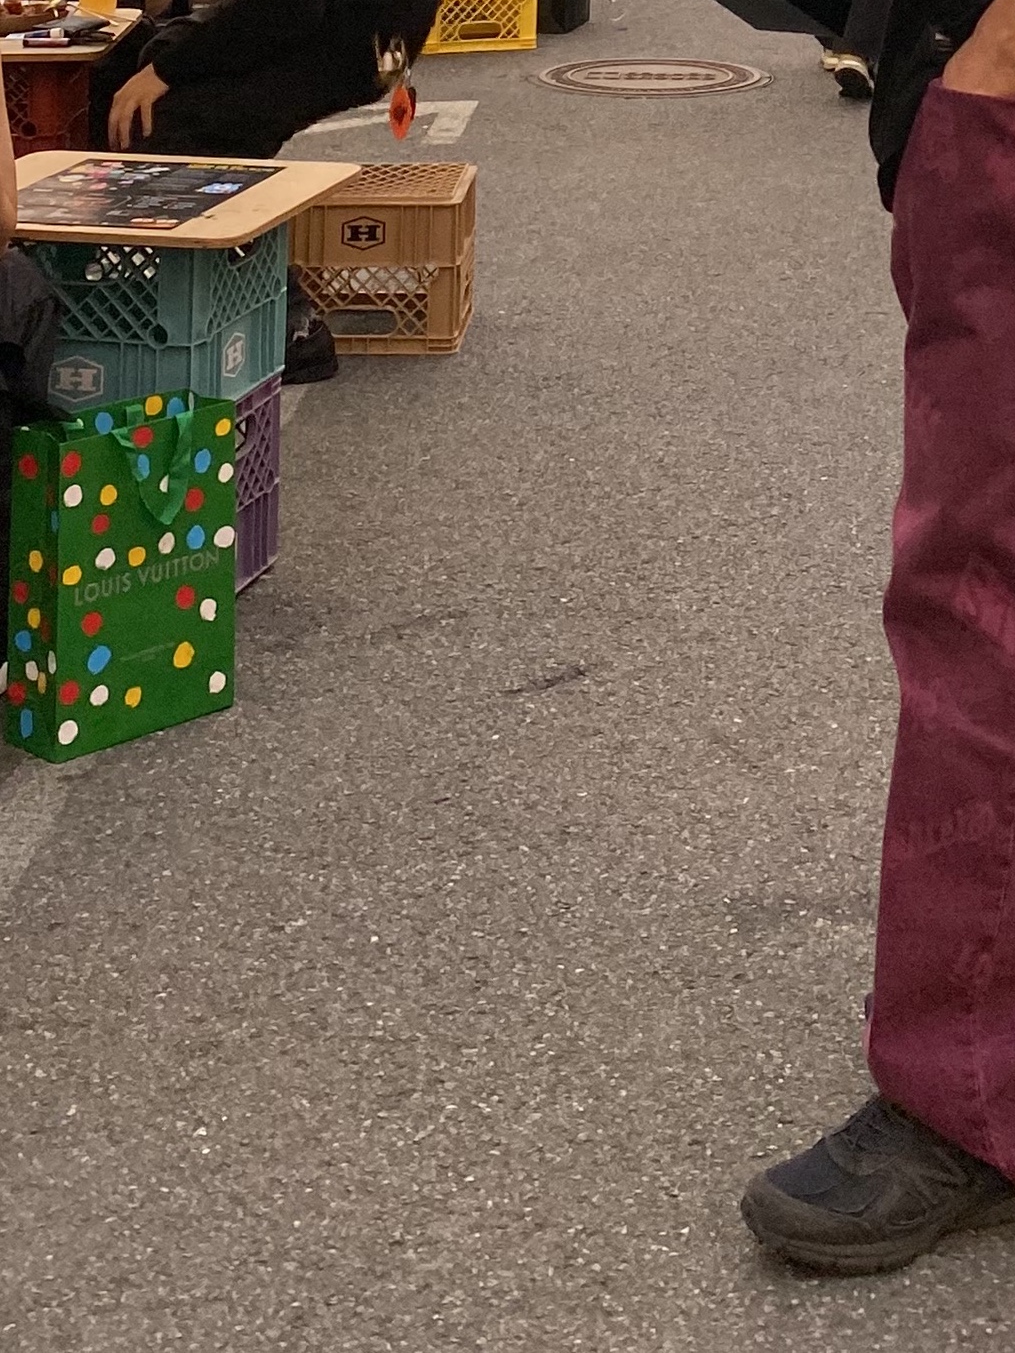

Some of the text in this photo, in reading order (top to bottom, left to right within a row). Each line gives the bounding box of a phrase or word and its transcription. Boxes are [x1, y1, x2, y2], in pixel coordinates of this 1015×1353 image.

[346, 225, 381, 242] H
[74, 548, 220, 606] LOUIS VUITTON
